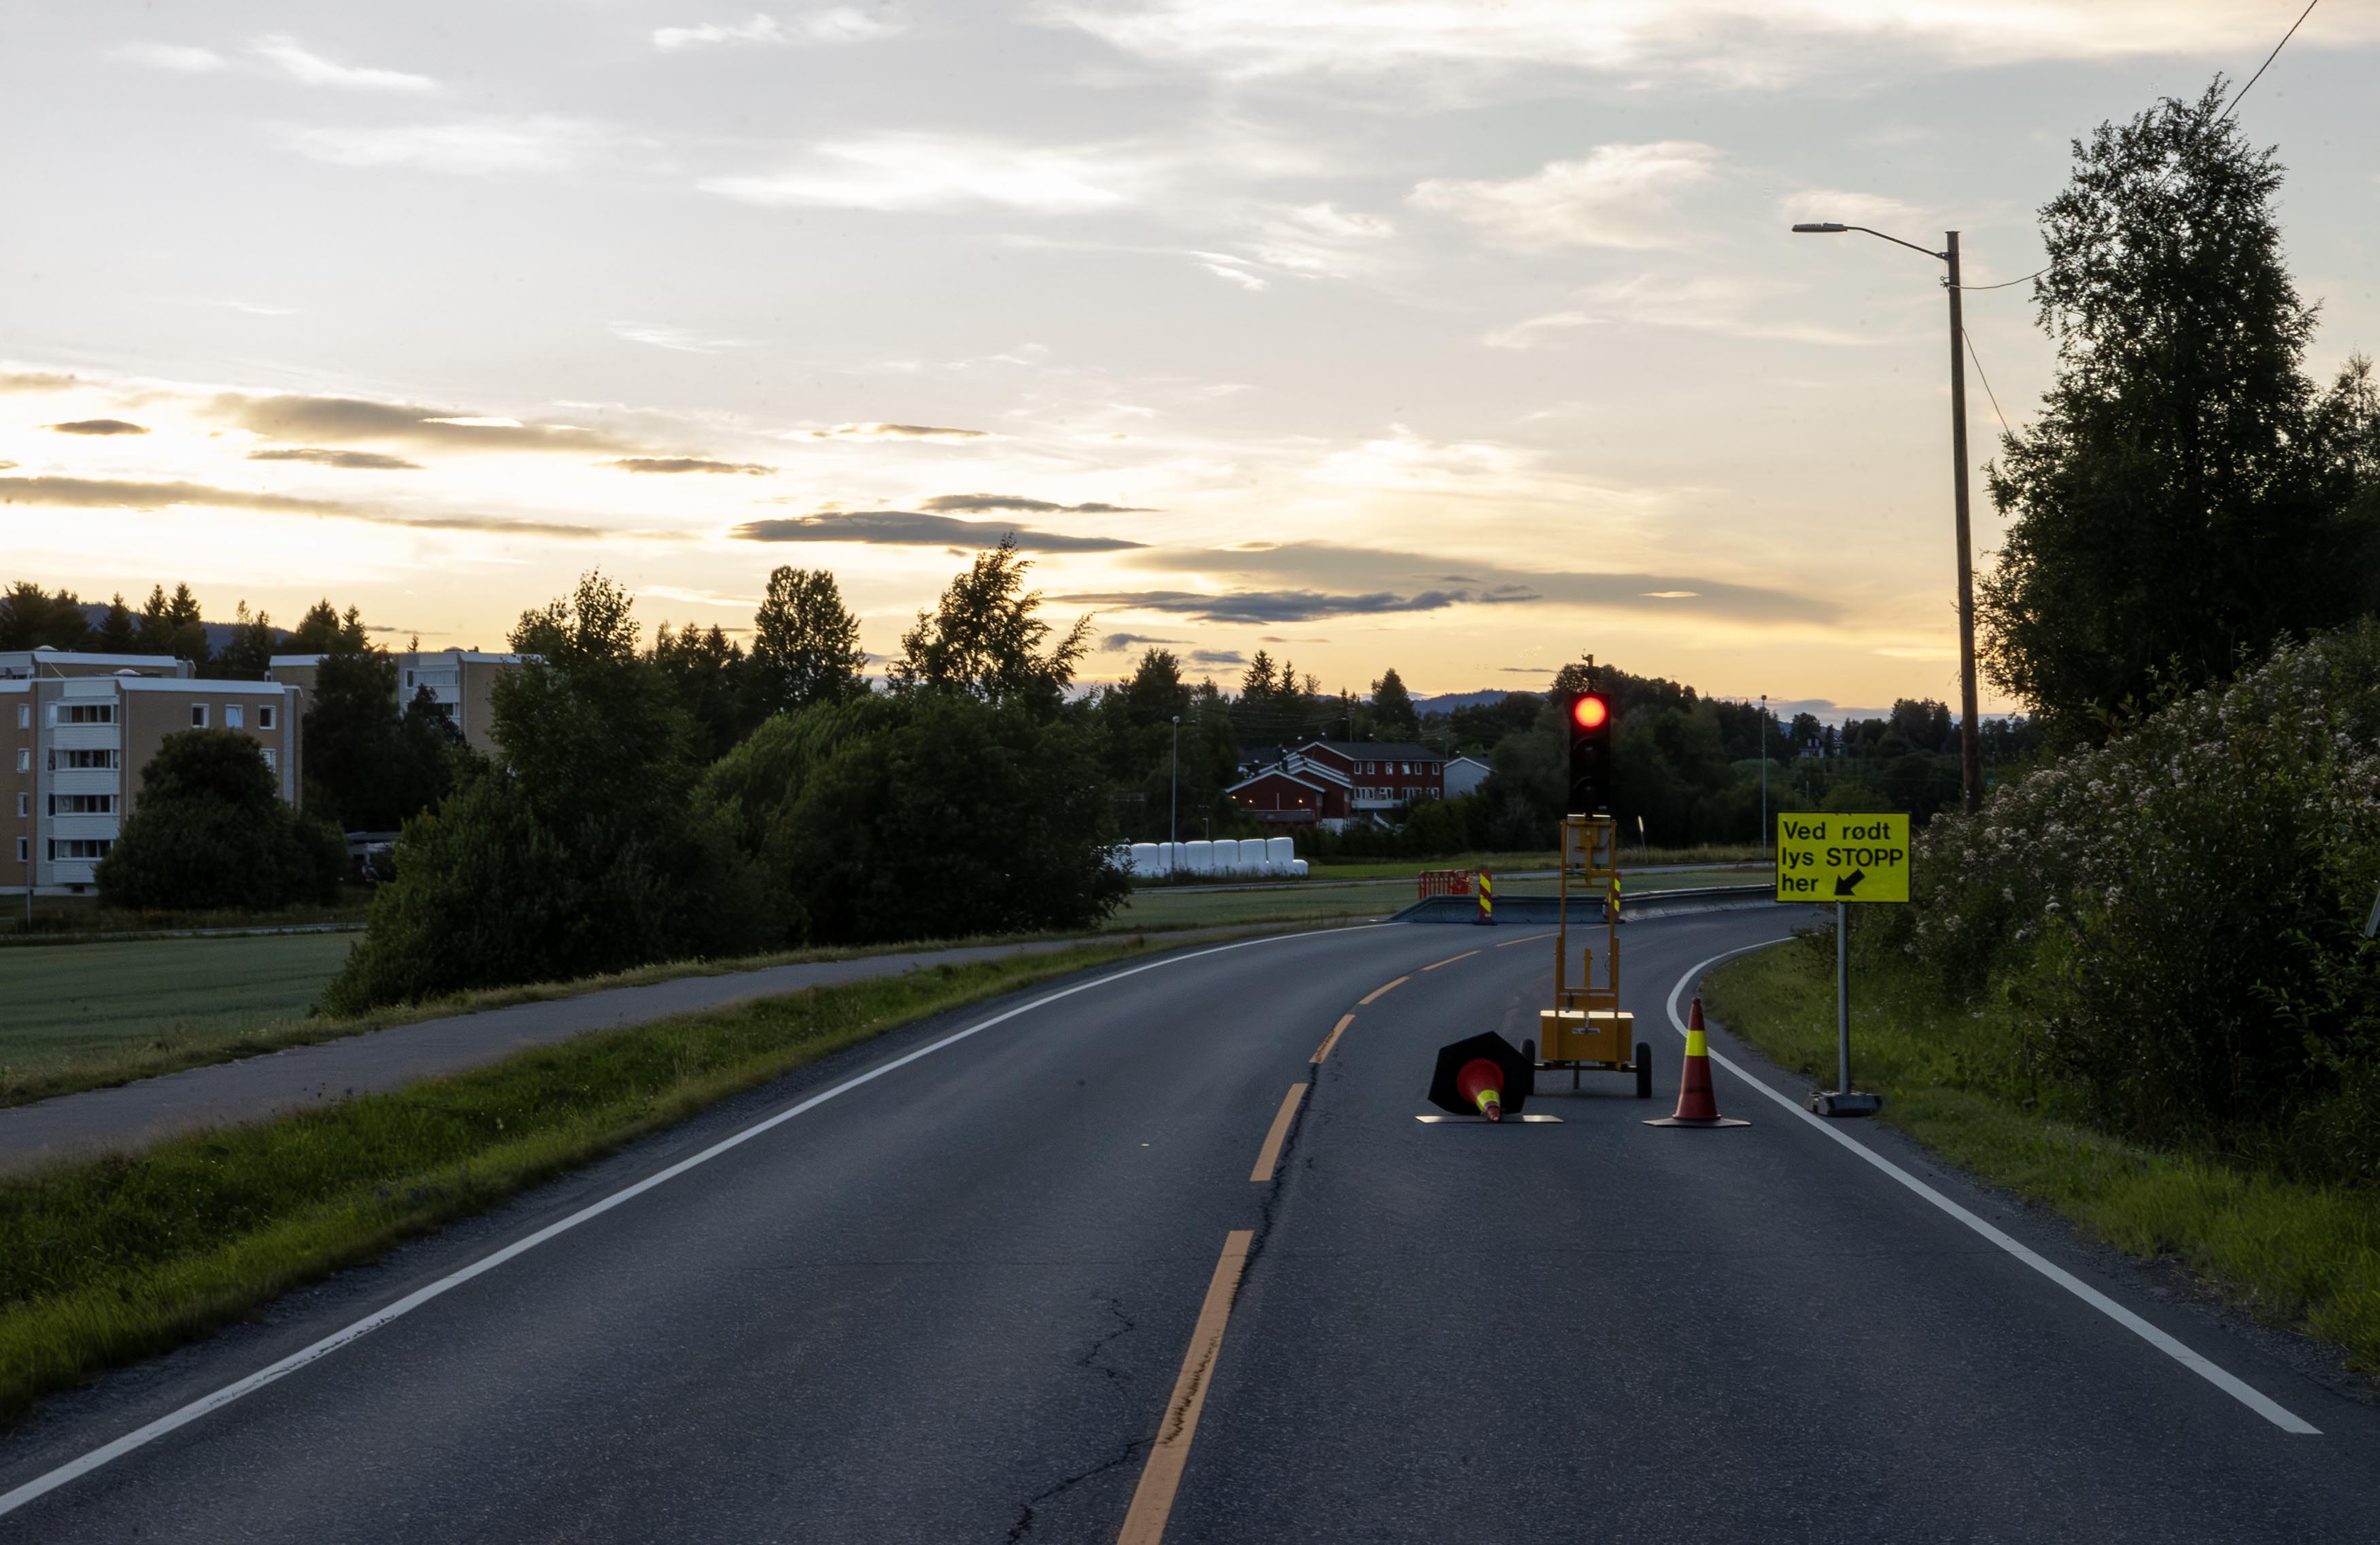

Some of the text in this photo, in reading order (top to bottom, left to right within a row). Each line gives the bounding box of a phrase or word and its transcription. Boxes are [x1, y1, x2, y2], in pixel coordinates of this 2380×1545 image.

[1783, 821, 1891, 841] Ved rødt
[1782, 847, 1903, 870] lys STOPP
[1782, 873, 1819, 892] her
